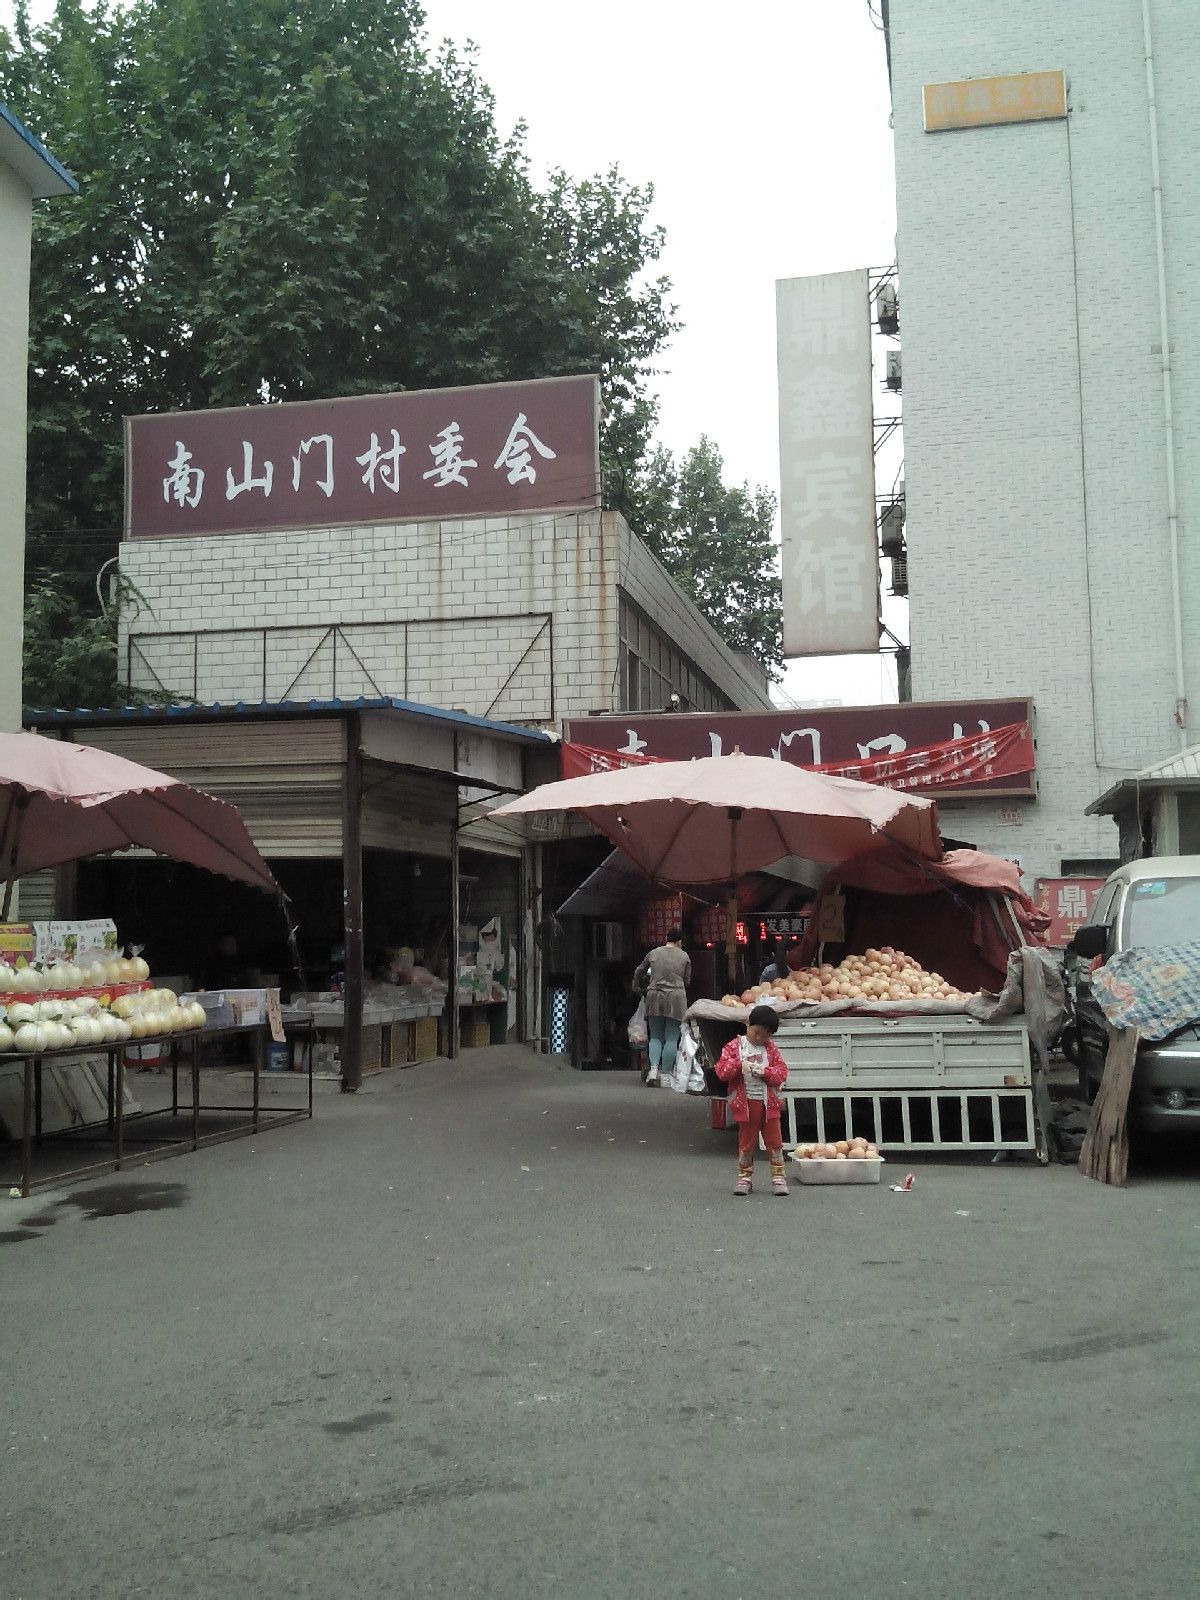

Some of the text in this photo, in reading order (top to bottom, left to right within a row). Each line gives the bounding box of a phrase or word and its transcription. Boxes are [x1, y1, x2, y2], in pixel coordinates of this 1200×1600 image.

[162, 412, 557, 508] 南山门村委会
